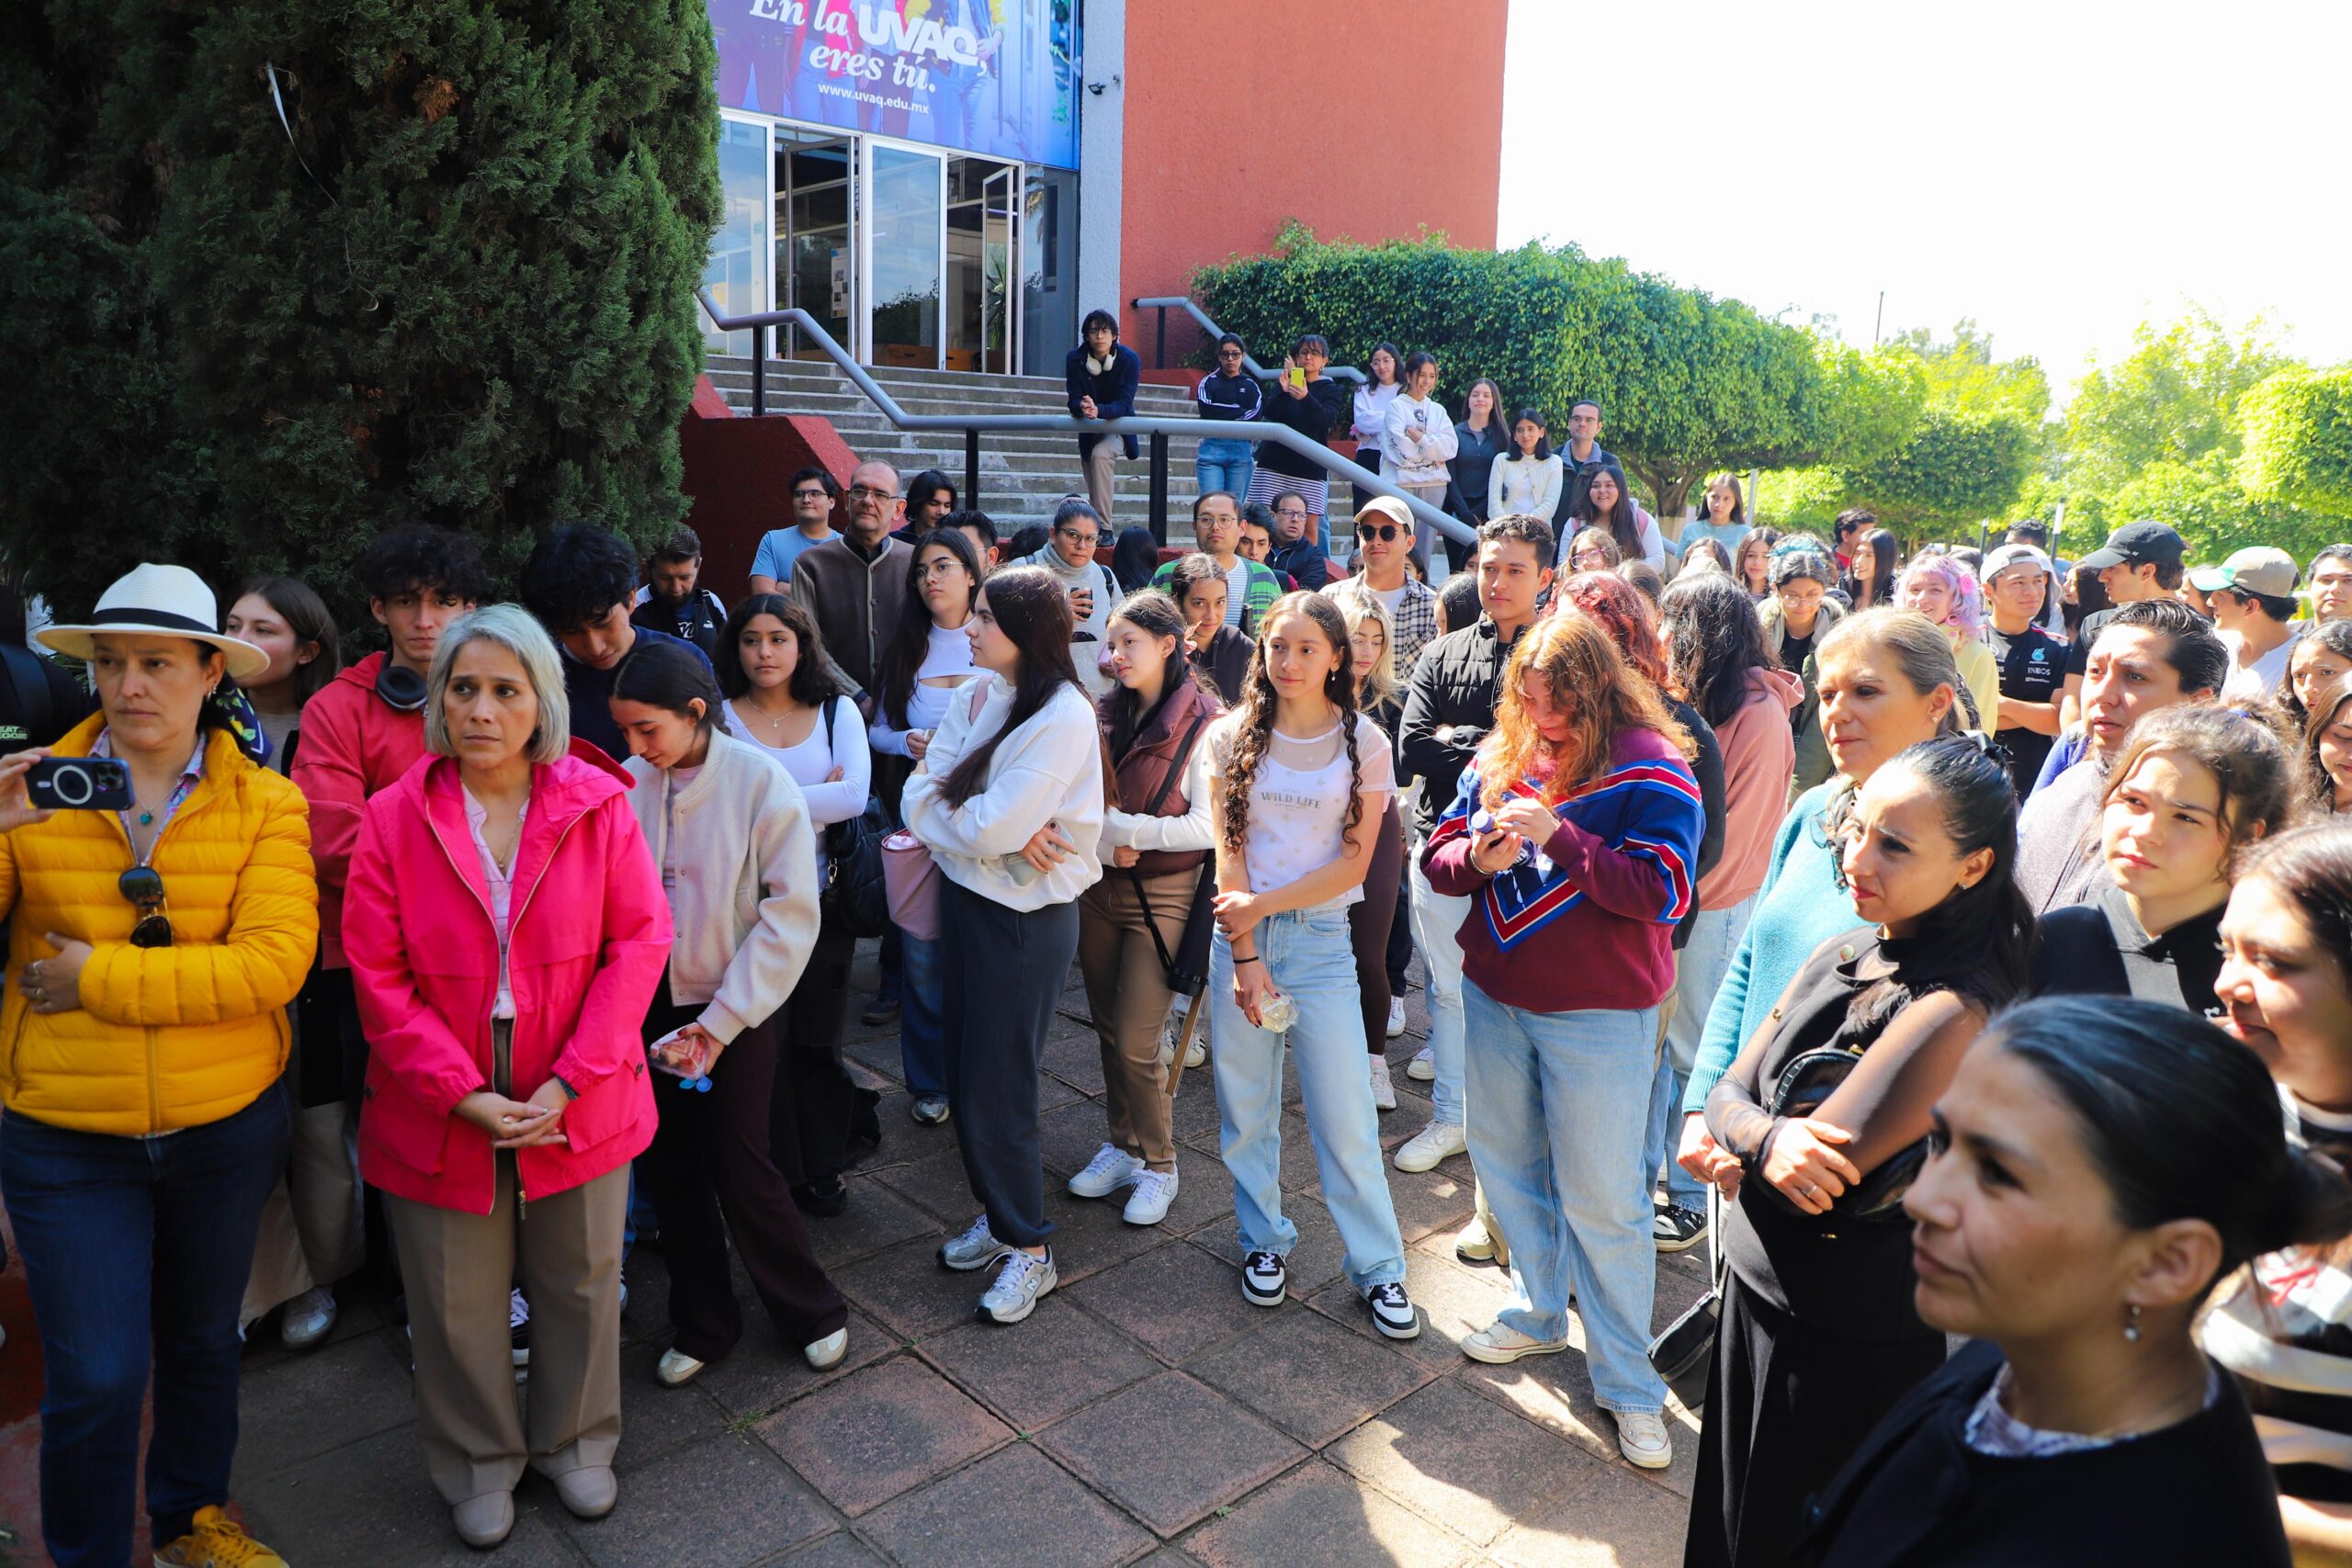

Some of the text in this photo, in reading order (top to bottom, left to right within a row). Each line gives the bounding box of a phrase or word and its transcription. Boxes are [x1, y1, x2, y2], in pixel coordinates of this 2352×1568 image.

[750, 0, 988, 77] En la UVAQ,
[809, 44, 936, 93] eres tú.
[818, 84, 930, 115] www.uvaq.edu.mx
[2028, 667, 2051, 676] INEOS
[1261, 792, 1293, 803] WILD
[1296, 795, 1322, 809] LIFE
